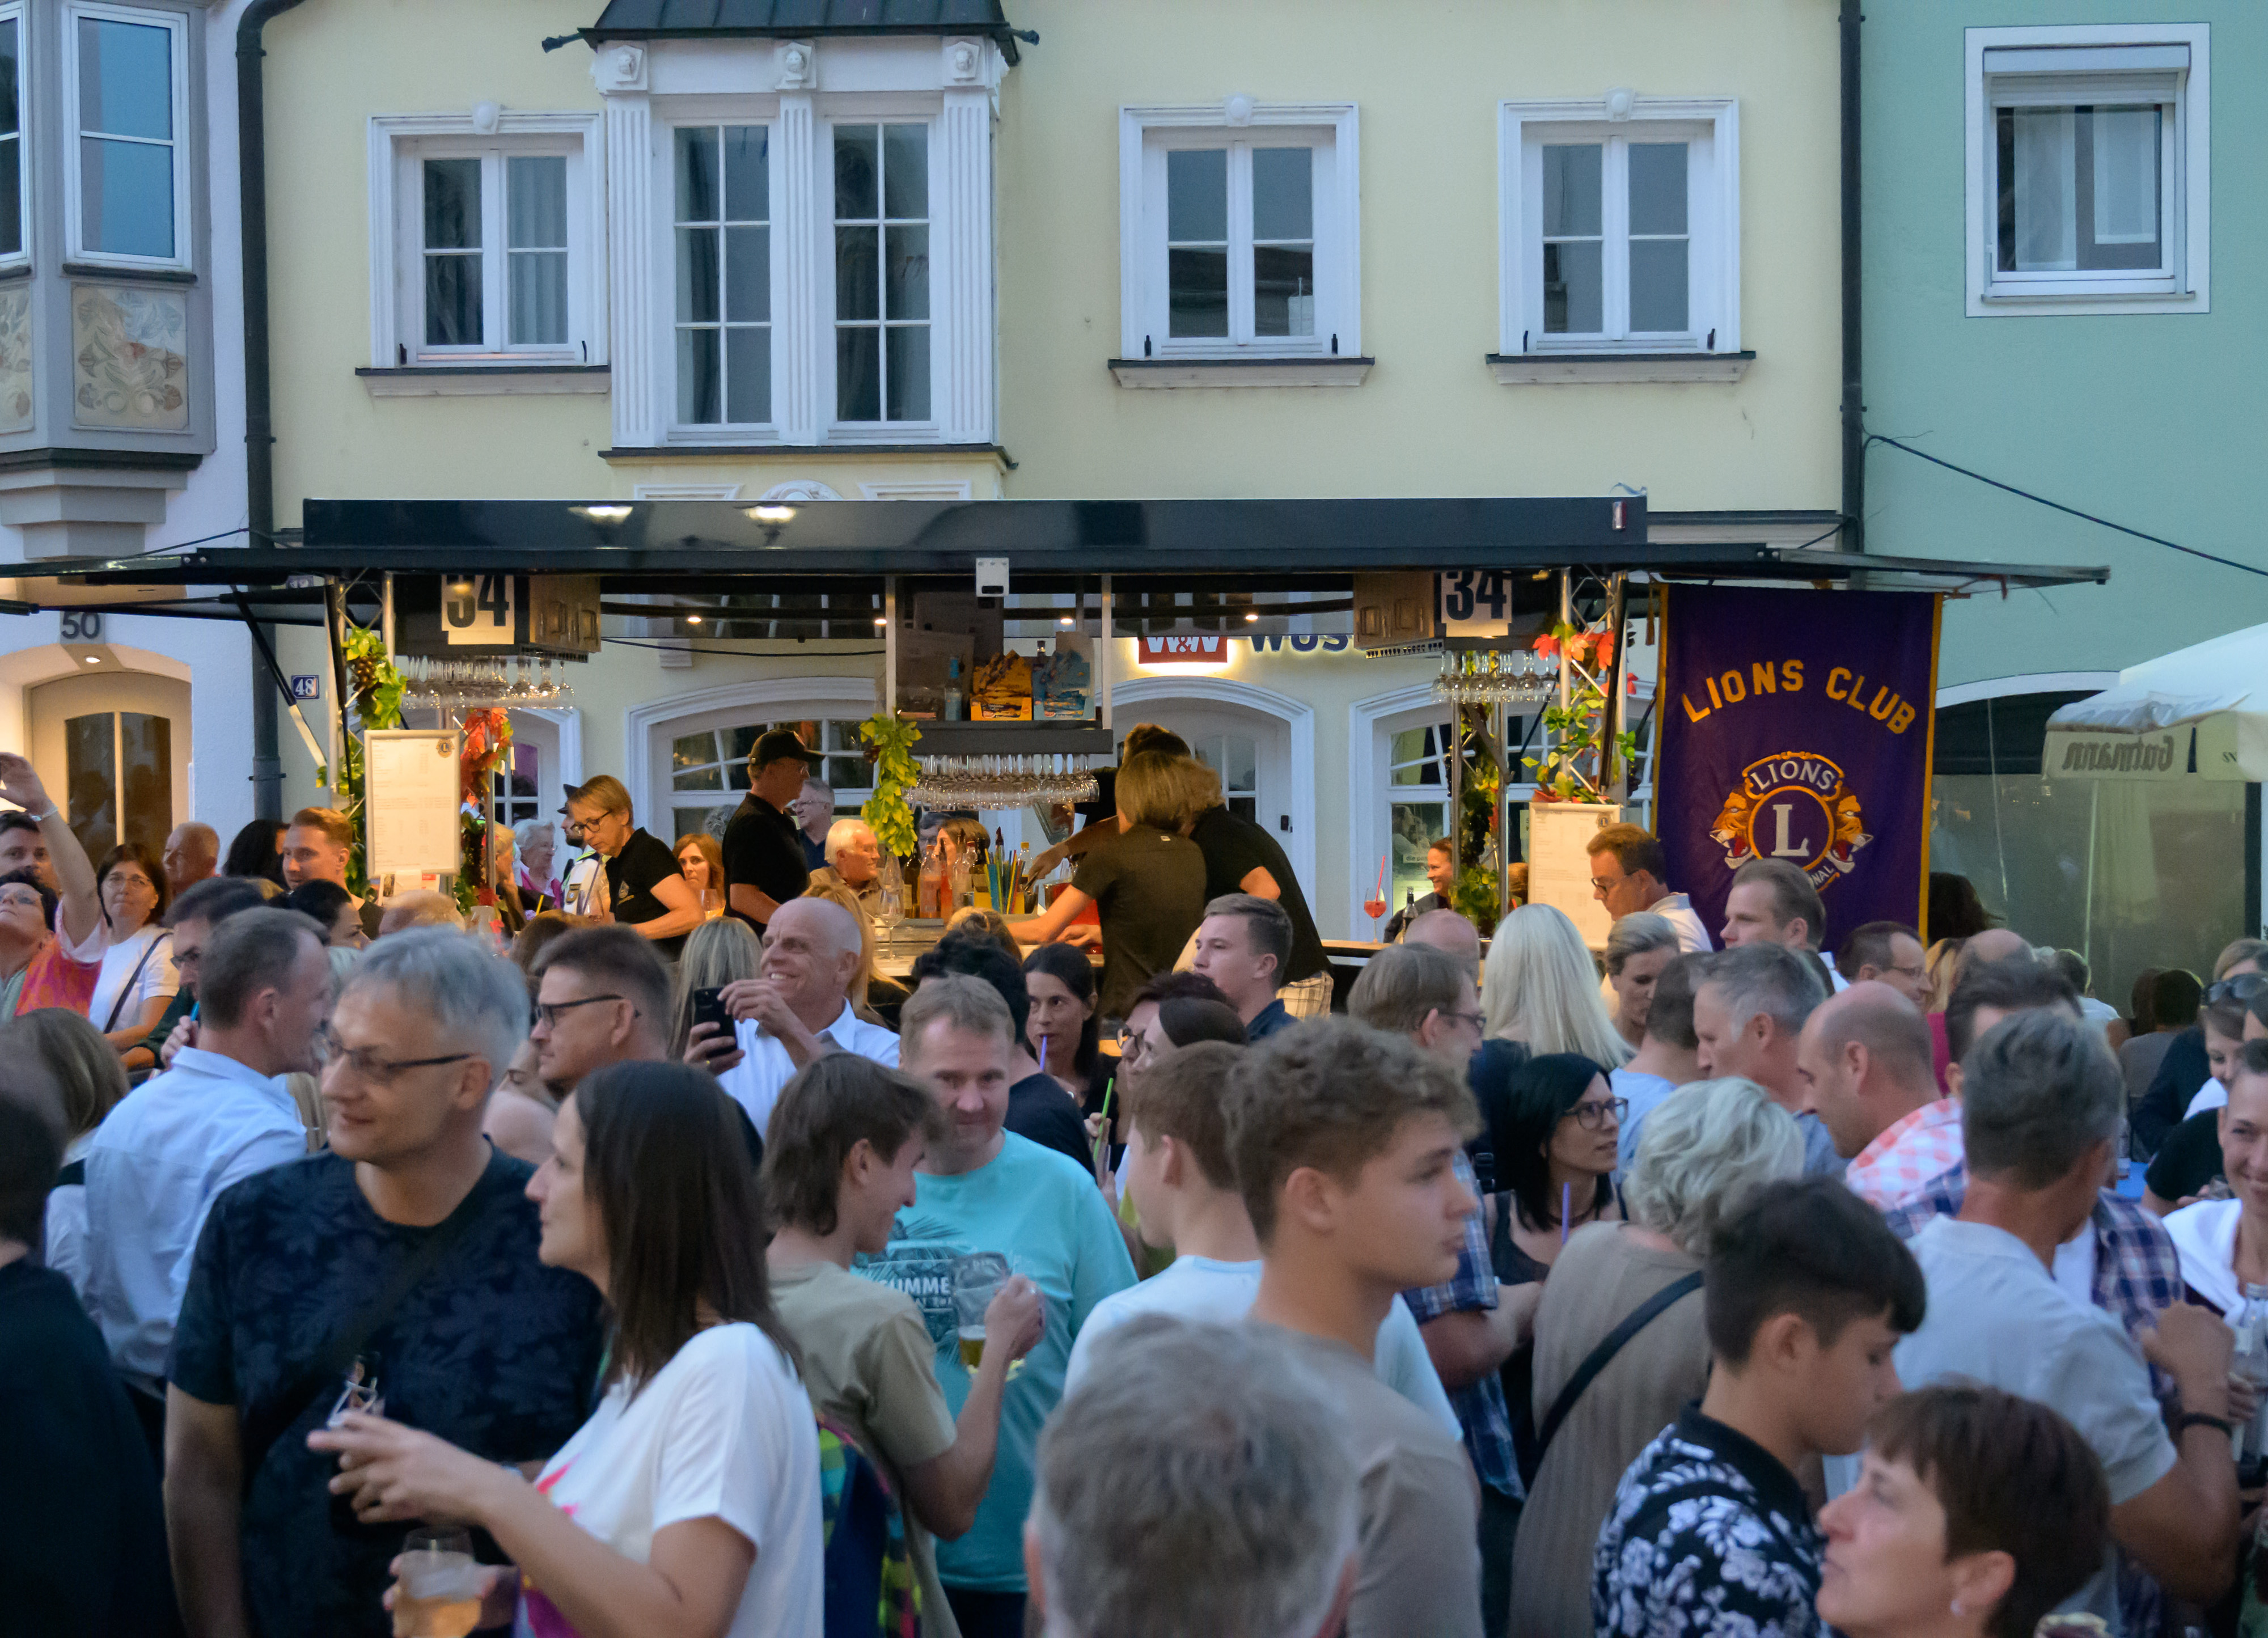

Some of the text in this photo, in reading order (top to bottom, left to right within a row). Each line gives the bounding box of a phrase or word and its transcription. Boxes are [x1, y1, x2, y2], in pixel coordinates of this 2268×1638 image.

[1446, 571, 1507, 620] 34
[61, 612, 100, 639] 50
[295, 678, 315, 696] 48
[1681, 659, 1915, 734] LIONS CLUB
[1750, 760, 1836, 790] LIONS
[1771, 804, 1810, 857] L
